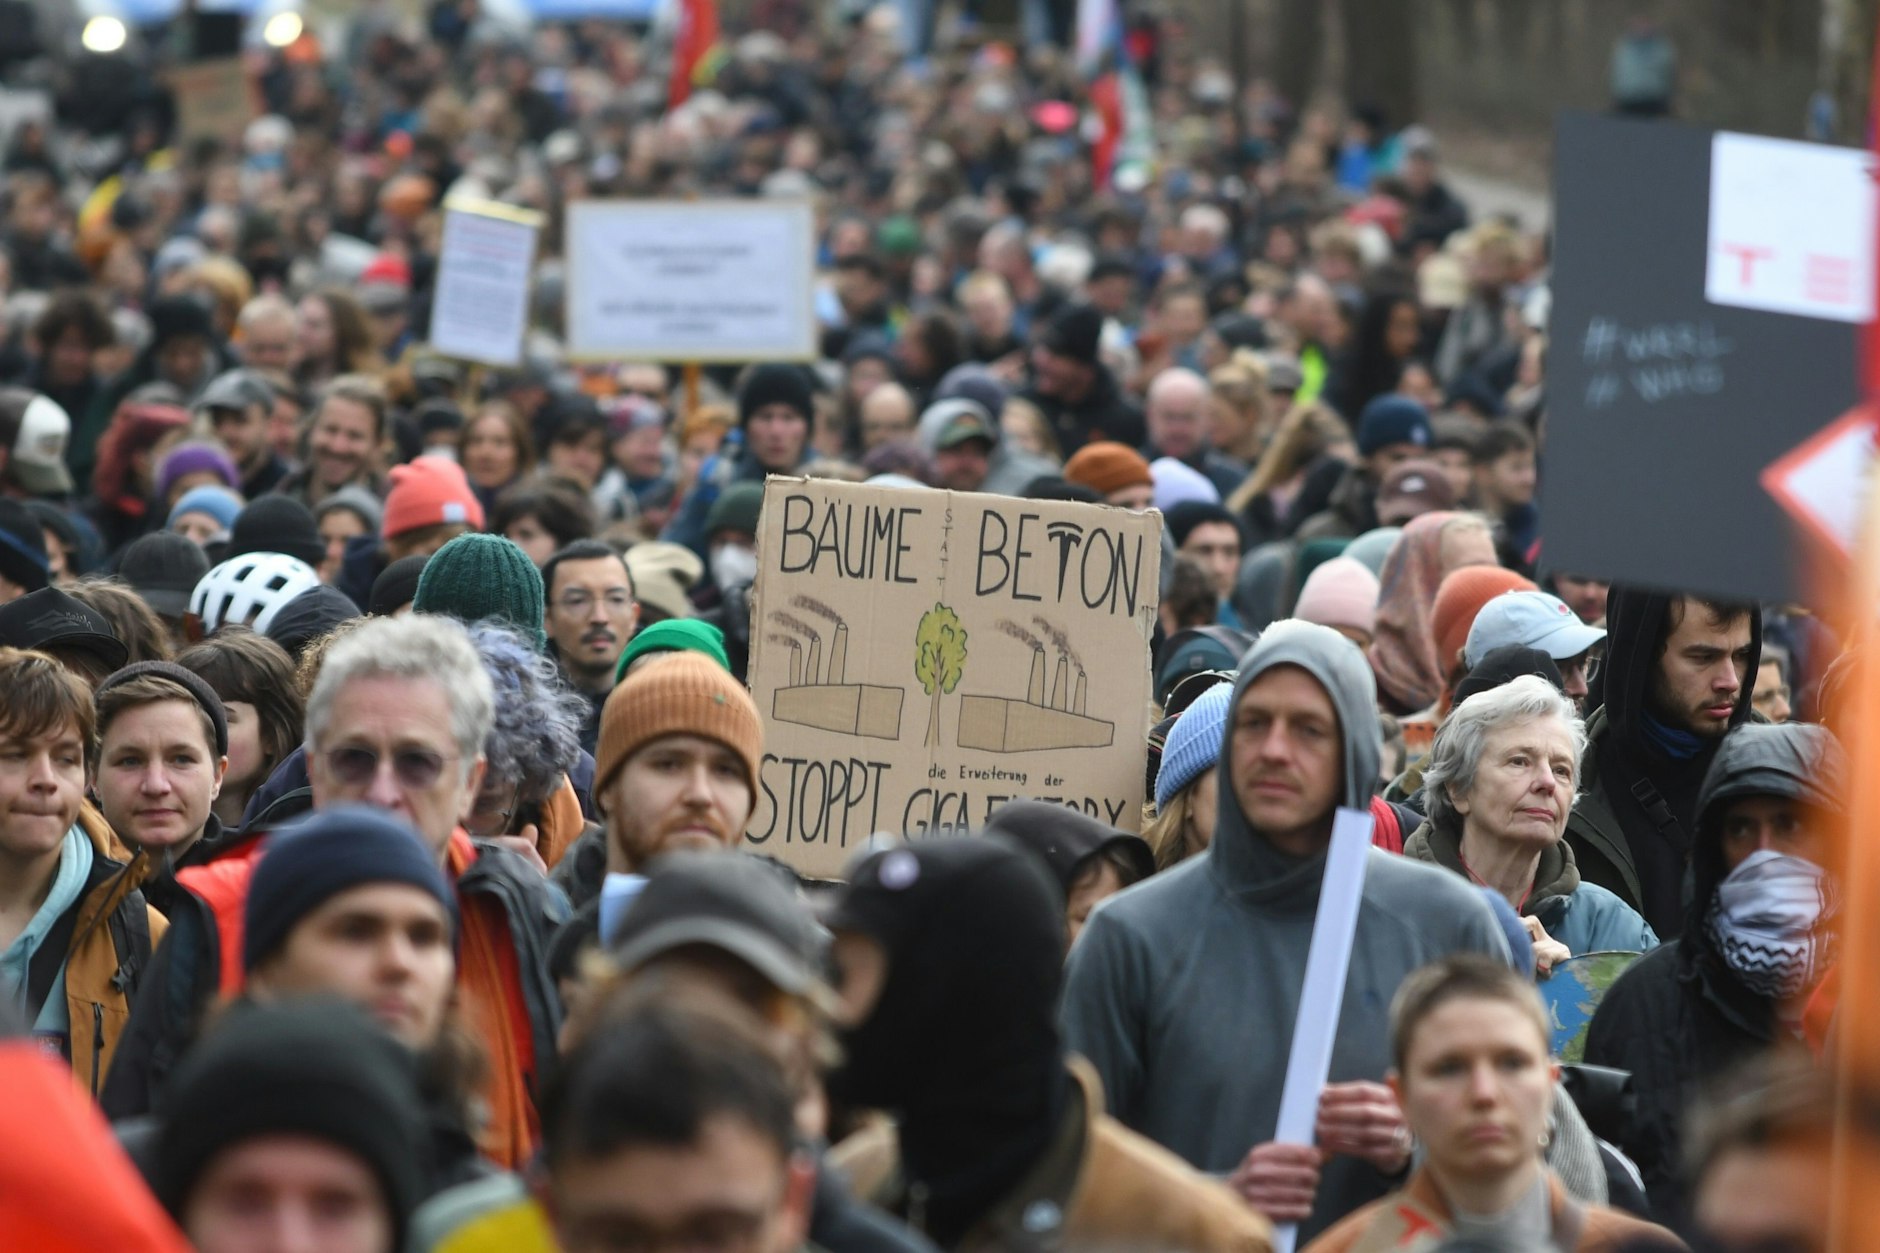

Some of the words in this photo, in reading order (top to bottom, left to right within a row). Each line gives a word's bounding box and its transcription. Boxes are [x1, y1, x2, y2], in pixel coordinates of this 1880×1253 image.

[780, 495, 922, 583] BÄUME
[937, 508, 953, 586] STATT
[975, 509, 1143, 617] BETON
[746, 753, 892, 848] STOPPT
[902, 788, 970, 840] GIGA
[928, 763, 946, 780] die
[960, 765, 1027, 785] Erweiterung
[1044, 774, 1065, 787] der
